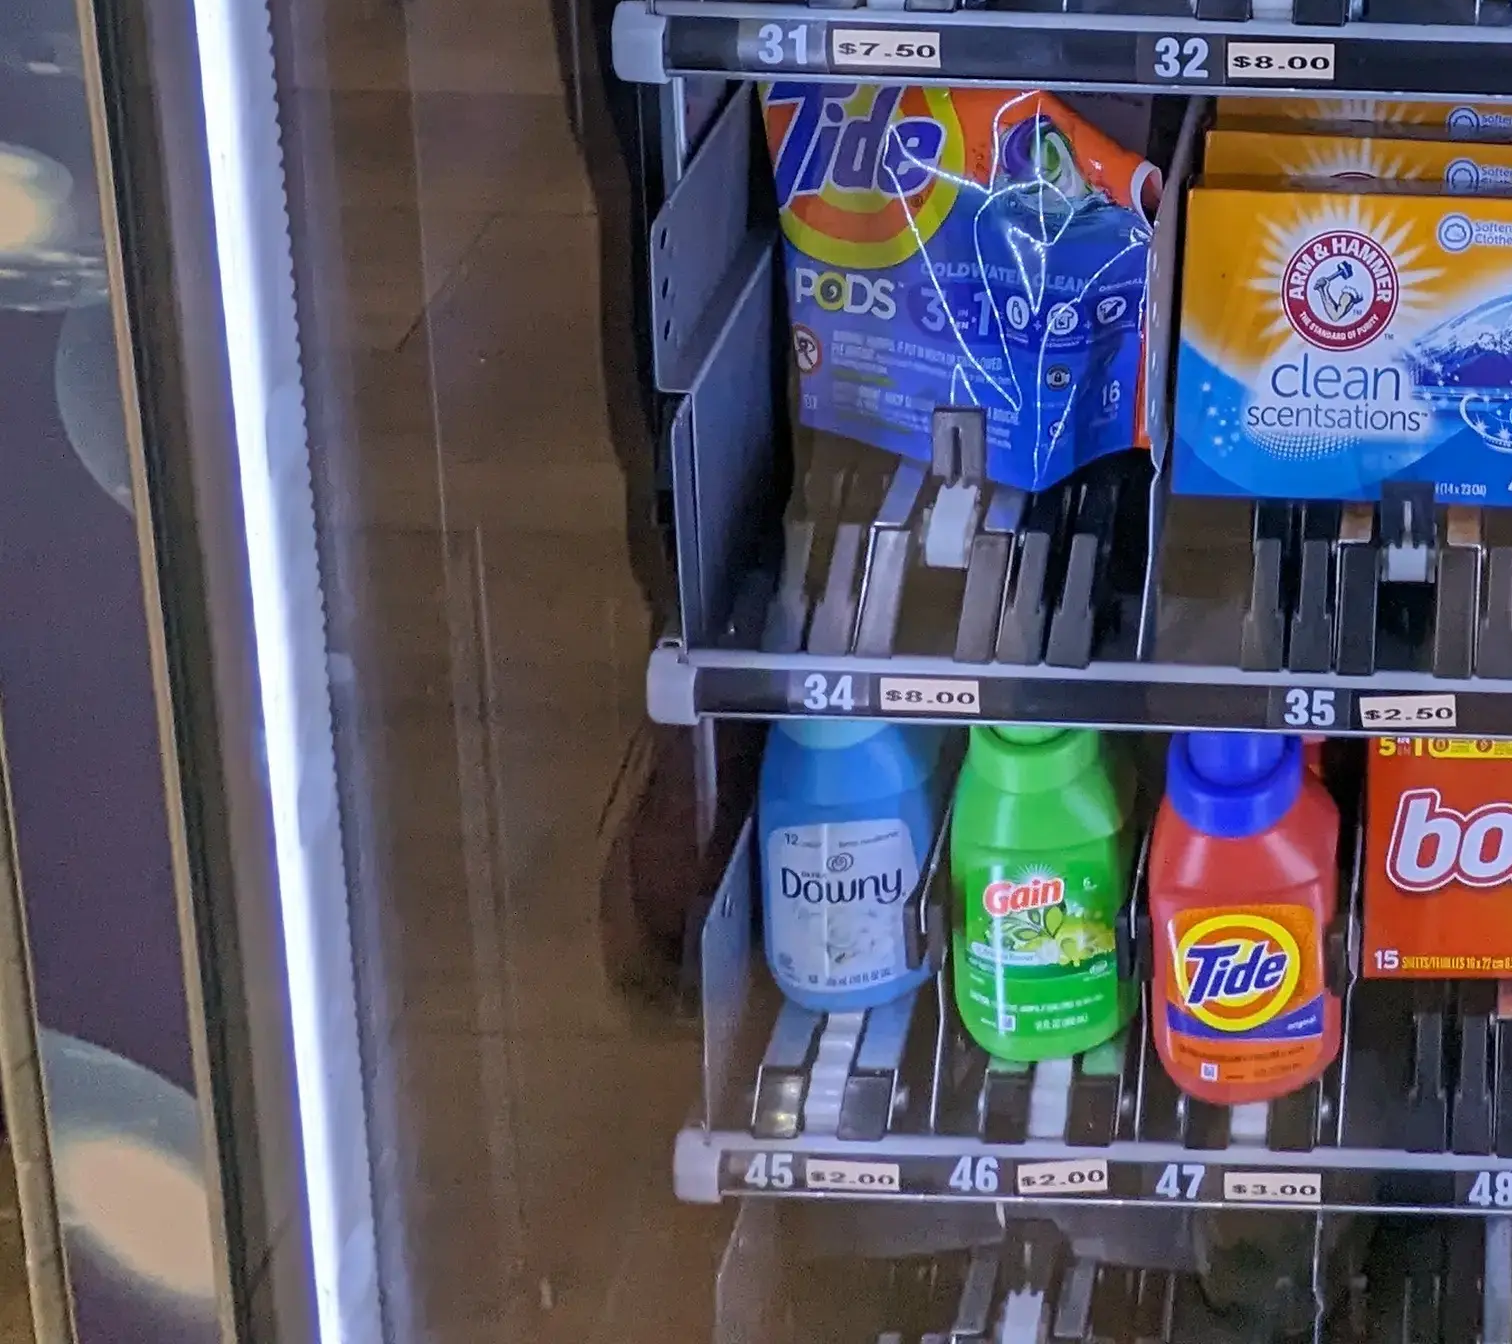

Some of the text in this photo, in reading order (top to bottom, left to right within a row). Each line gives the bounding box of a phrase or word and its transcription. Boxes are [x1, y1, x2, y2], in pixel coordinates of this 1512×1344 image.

[758, 23, 808, 65] 31
[838, 42, 936, 58] $7.50
[1154, 37, 1209, 78] 32
[1233, 56, 1330, 70] $8.00
[765, 82, 948, 209] Tide
[1289, 237, 1392, 302] ARM & HAMMER
[795, 268, 896, 320] PODS
[920, 287, 946, 332] 3
[1270, 353, 1400, 402] clean
[1247, 402, 1421, 432] scentsations
[1461, 483, 1472, 496] 23
[804, 673, 854, 711] 34
[885, 690, 975, 704] $8.00
[1284, 688, 1335, 726] 35
[1364, 707, 1453, 720] $2.50
[784, 833, 799, 845] 12
[781, 867, 902, 905] Downy
[985, 878, 1064, 915] Gain
[1185, 941, 1289, 1007] Tide
[1374, 949, 1399, 969] 15
[745, 1153, 793, 1189] 45
[810, 1170, 895, 1186] $2.00
[950, 1156, 999, 1193] 46
[1021, 1169, 1105, 1186] $2.00
[1155, 1164, 1206, 1199] 47
[1231, 1183, 1317, 1197] $3.00
